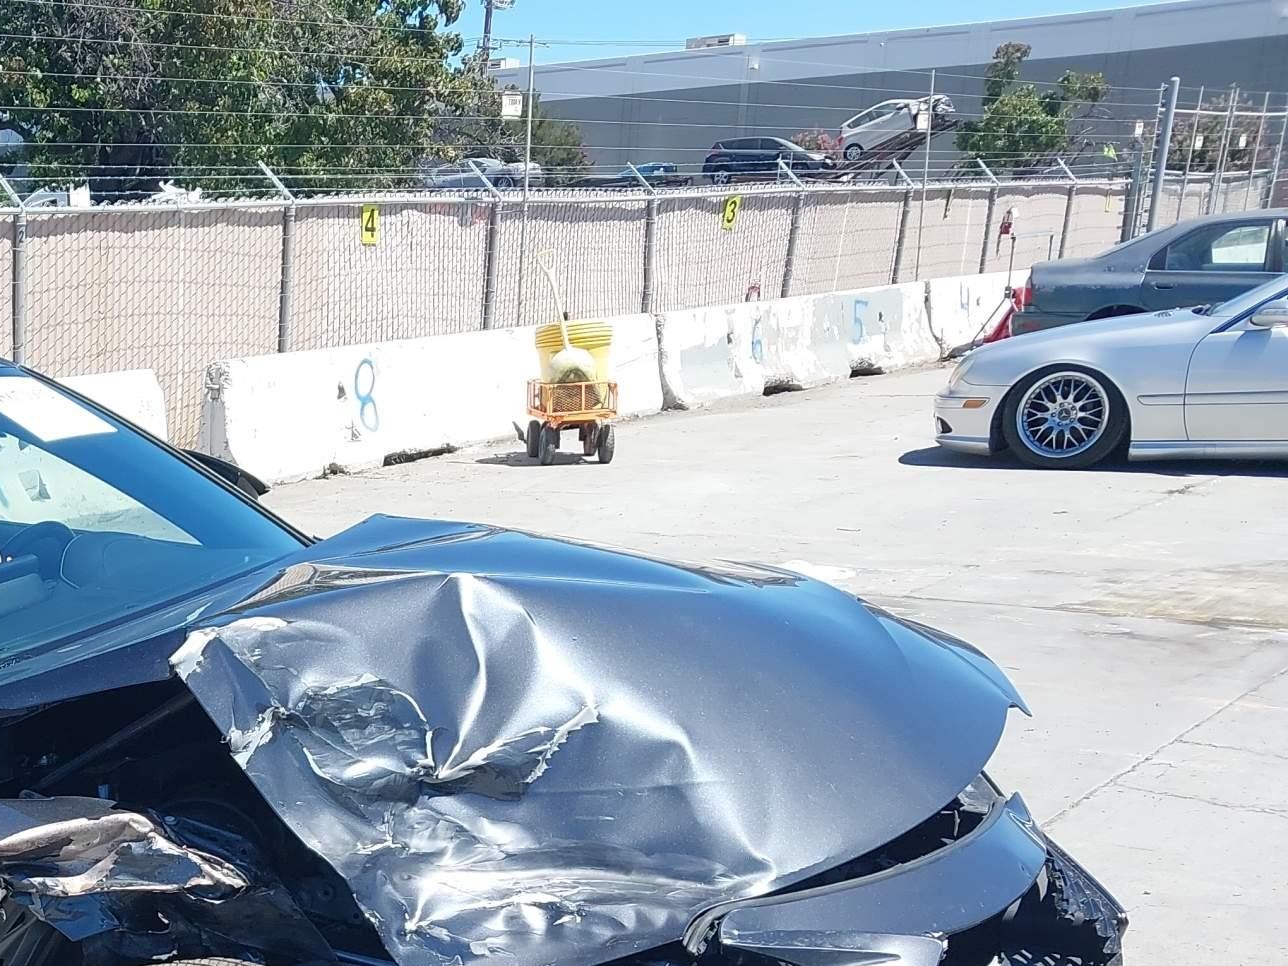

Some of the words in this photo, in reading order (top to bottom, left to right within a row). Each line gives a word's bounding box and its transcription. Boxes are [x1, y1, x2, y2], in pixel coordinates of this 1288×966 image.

[364, 208, 376, 238] 4
[727, 199, 737, 223] 3
[854, 299, 869, 345] 5
[354, 358, 380, 432] 8
